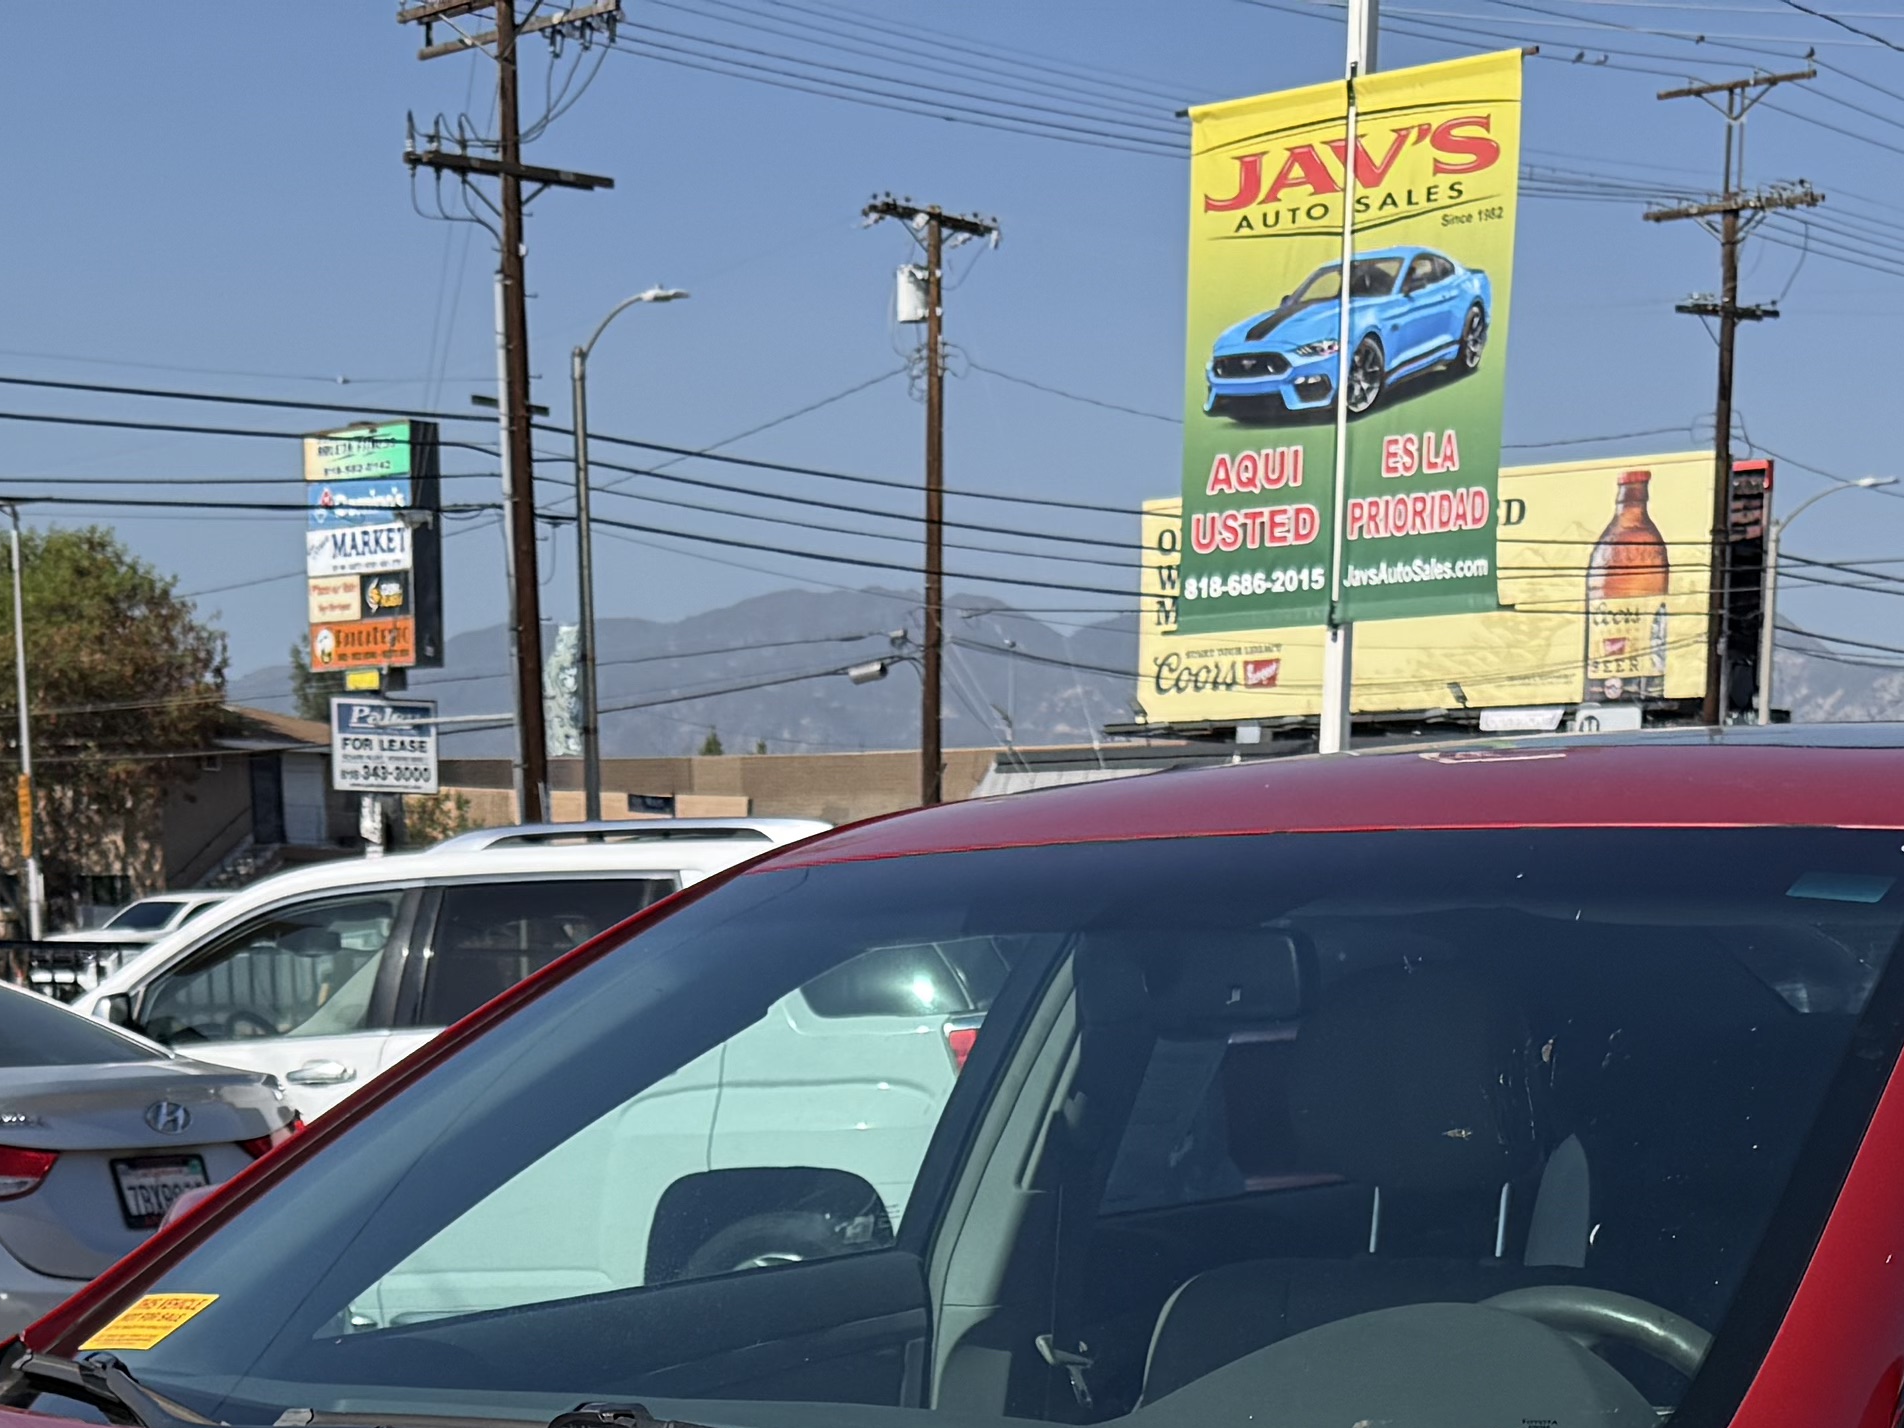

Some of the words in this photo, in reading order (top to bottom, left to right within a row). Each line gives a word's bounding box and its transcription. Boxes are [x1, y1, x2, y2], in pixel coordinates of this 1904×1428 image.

[1204, 114, 1501, 214] JAV'S
[1234, 203, 1329, 233] AUTO
[1354, 181, 1464, 213] SALES
[1441, 213, 1473, 227] Since
[1206, 445, 1304, 495] AQUI
[1381, 433, 1418, 478] ES
[1423, 429, 1460, 473] LA
[1191, 504, 1320, 554] USTED
[1347, 487, 1489, 540] PRIORIDAD
[332, 528, 405, 559] MARKET
[1184, 568, 1325, 600] 818-686-2015
[1343, 557, 1489, 588] JavsAutoSales.com
[1154, 652, 1240, 695] Coors
[342, 737, 374, 751] FOR
[379, 739, 427, 753] LEASE
